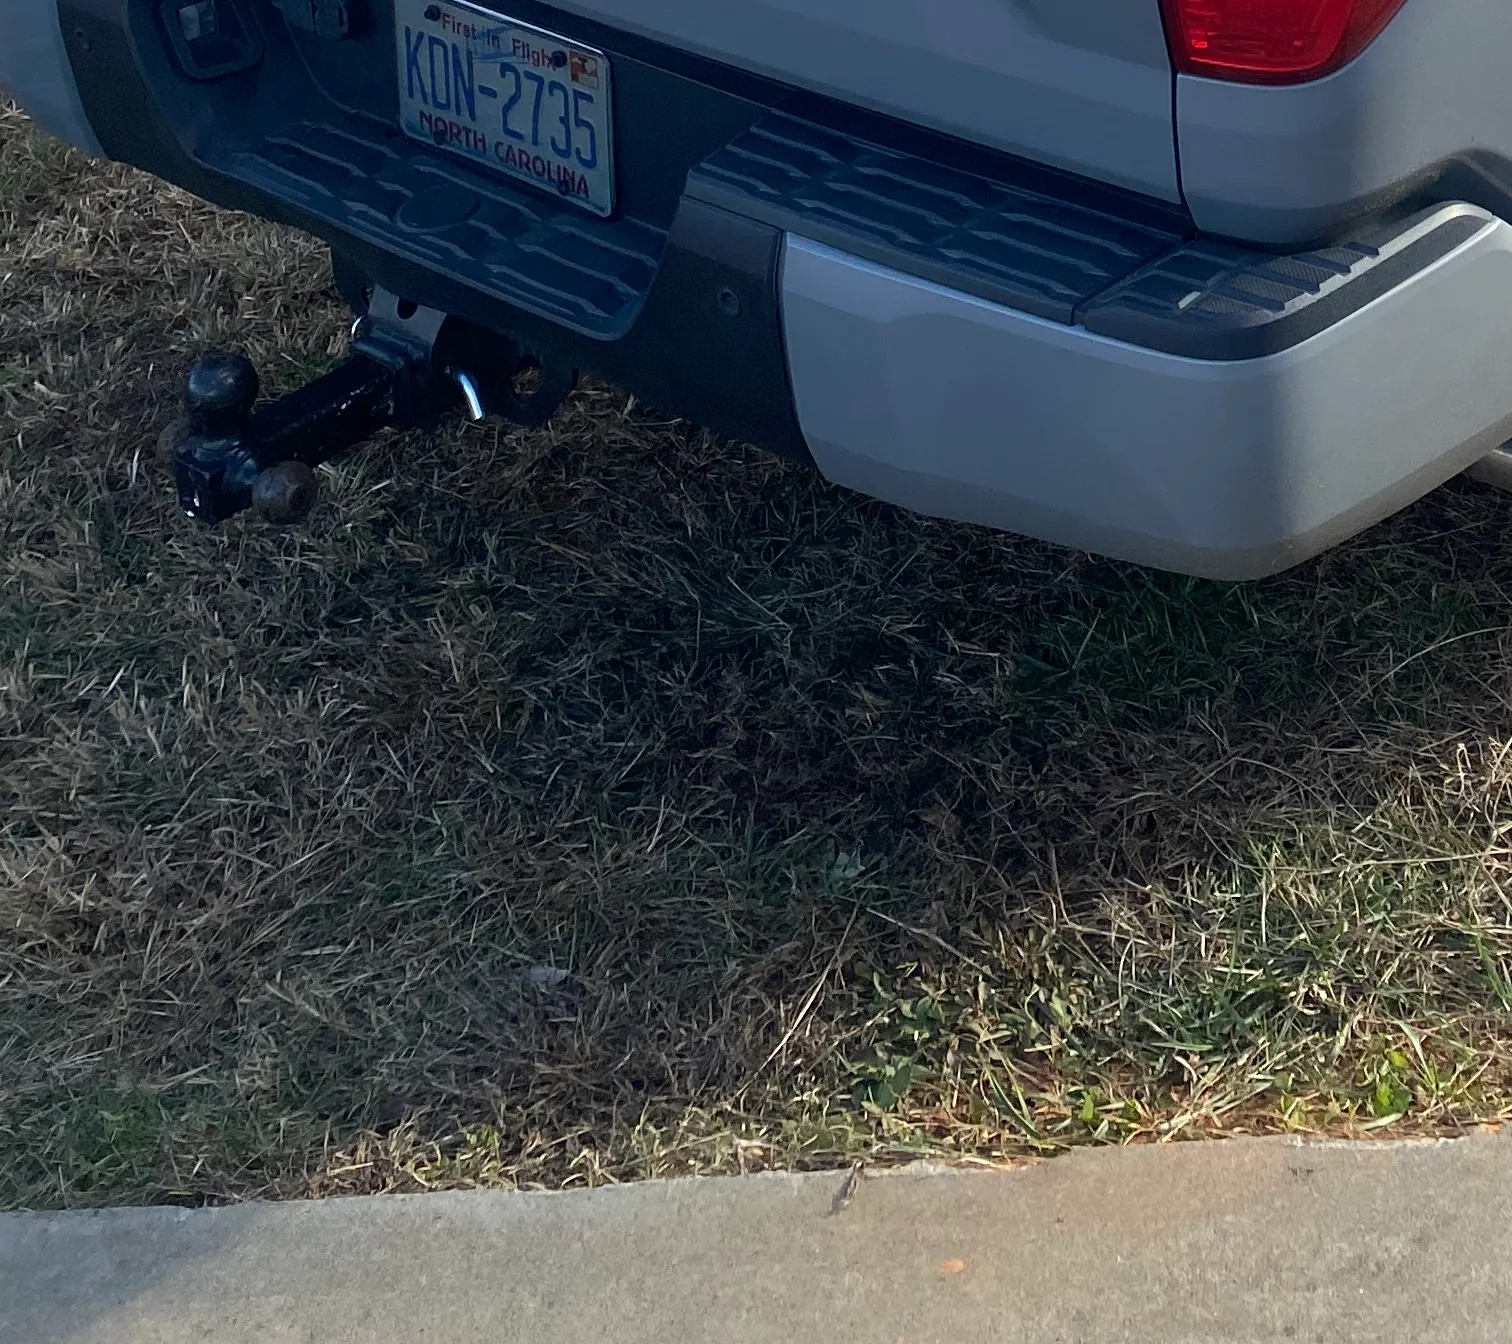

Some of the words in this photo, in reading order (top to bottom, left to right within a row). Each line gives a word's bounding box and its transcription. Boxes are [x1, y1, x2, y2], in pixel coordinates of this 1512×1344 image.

[441, 14, 478, 41] First
[512, 36, 559, 72] Fligh
[404, 25, 597, 170] KDN-2735
[419, 110, 488, 156] NORTH
[494, 140, 590, 200] CAROLINA
